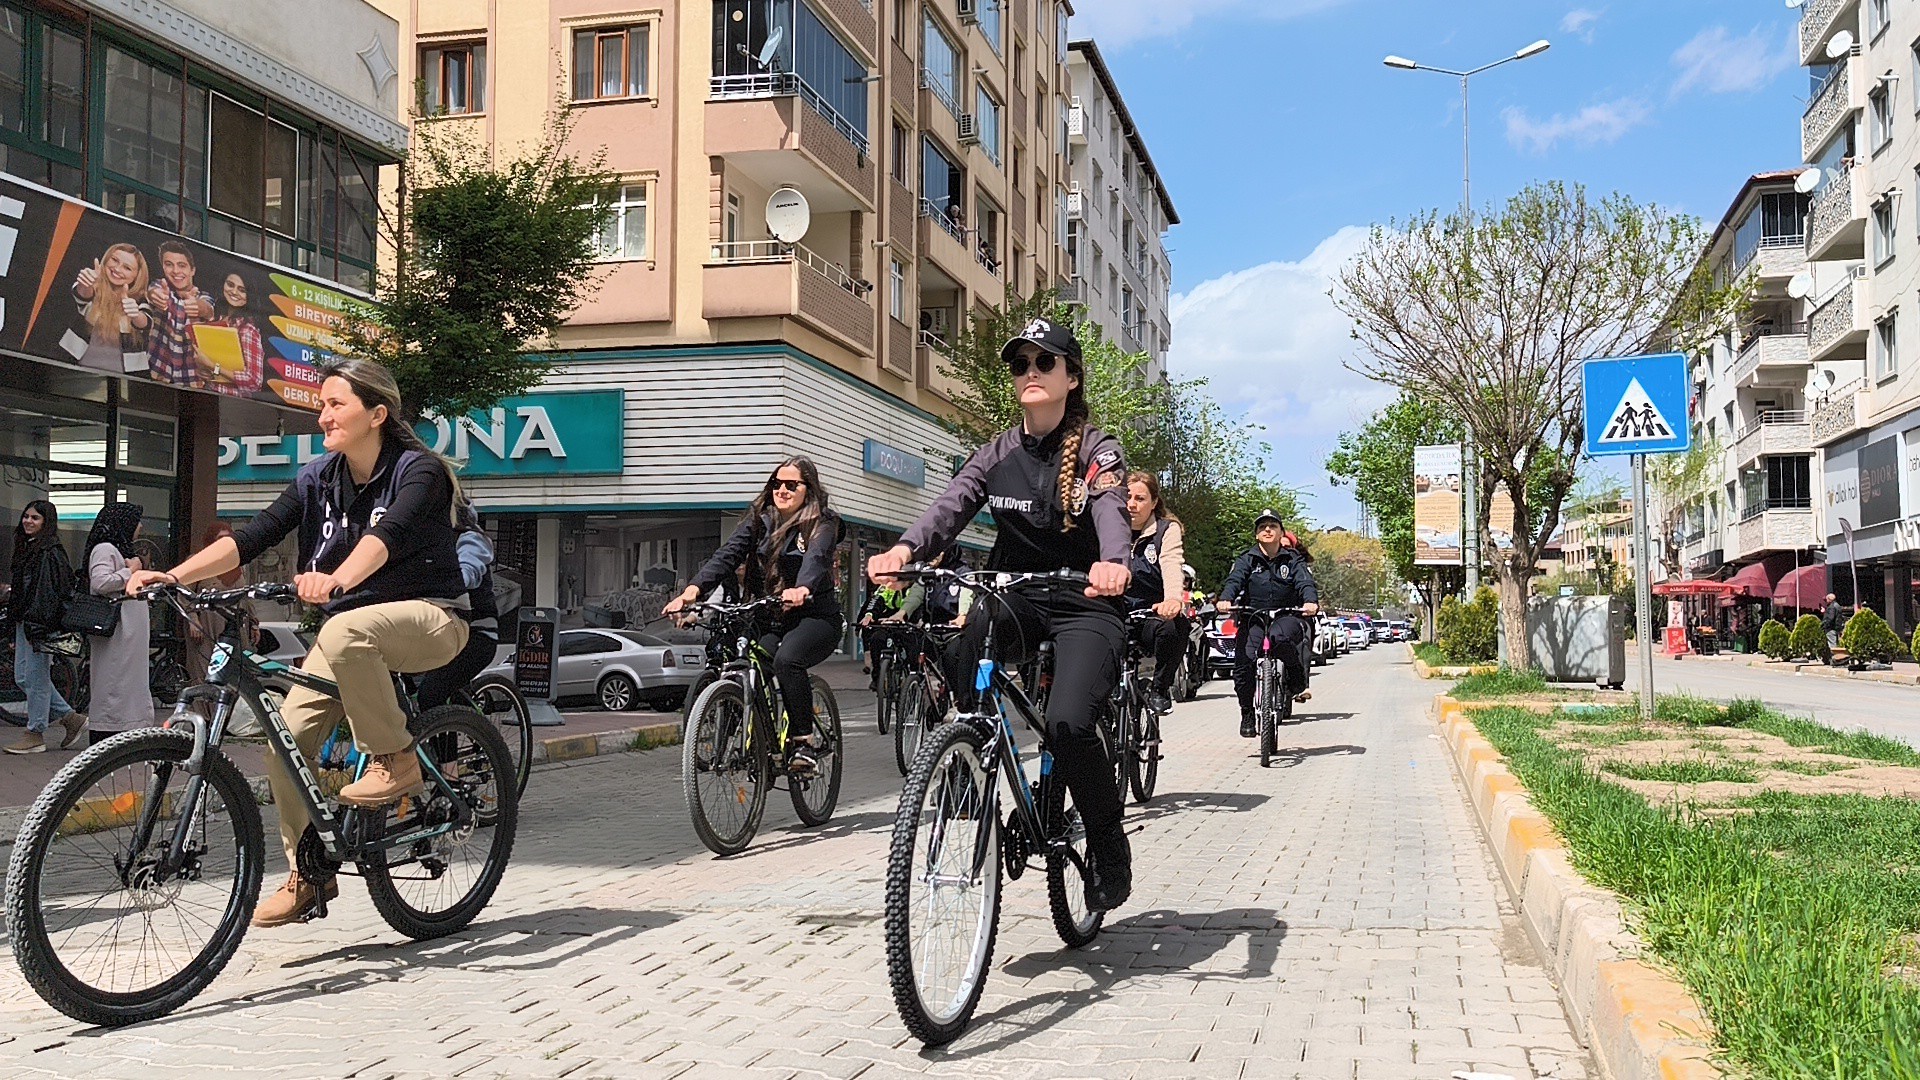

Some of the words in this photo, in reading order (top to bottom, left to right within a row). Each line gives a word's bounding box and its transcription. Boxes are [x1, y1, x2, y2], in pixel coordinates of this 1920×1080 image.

[303, 289, 314, 301] 12
[283, 386, 310, 403] DERS
[1004, 496, 1033, 513] KUVVET
[258, 692, 335, 821] GEOTECH
